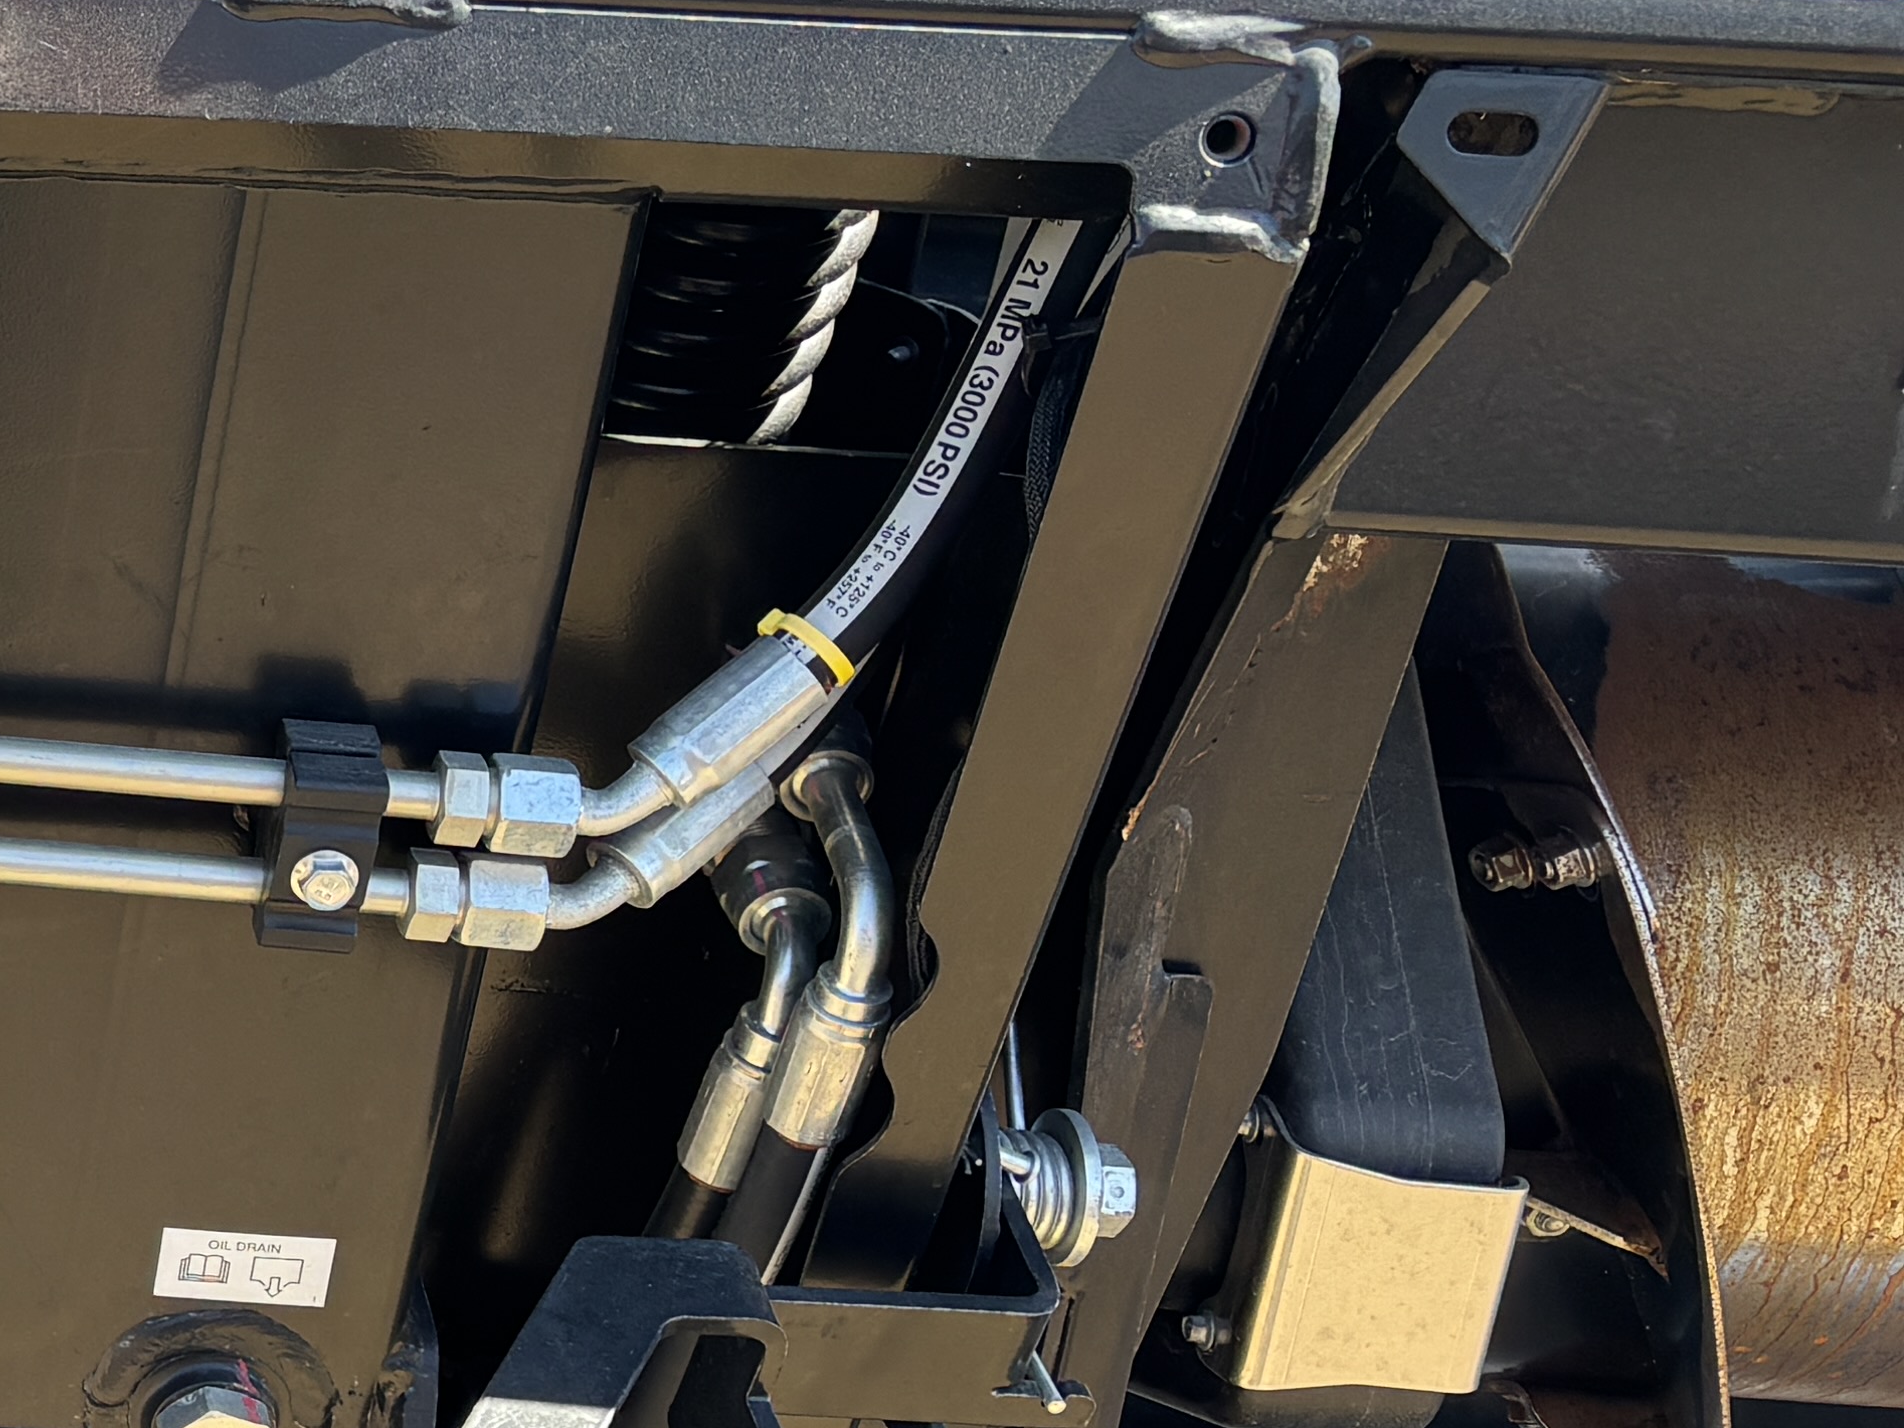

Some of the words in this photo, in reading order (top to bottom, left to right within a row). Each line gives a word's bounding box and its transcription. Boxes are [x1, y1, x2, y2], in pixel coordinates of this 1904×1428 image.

[1021, 258, 1051, 291] 21
[983, 296, 1034, 359] MPa
[944, 363, 1002, 438] (3000
[911, 439, 962, 498] PSI)
[208, 1239, 232, 1252] OIL
[236, 1241, 282, 1255] DRAIN
